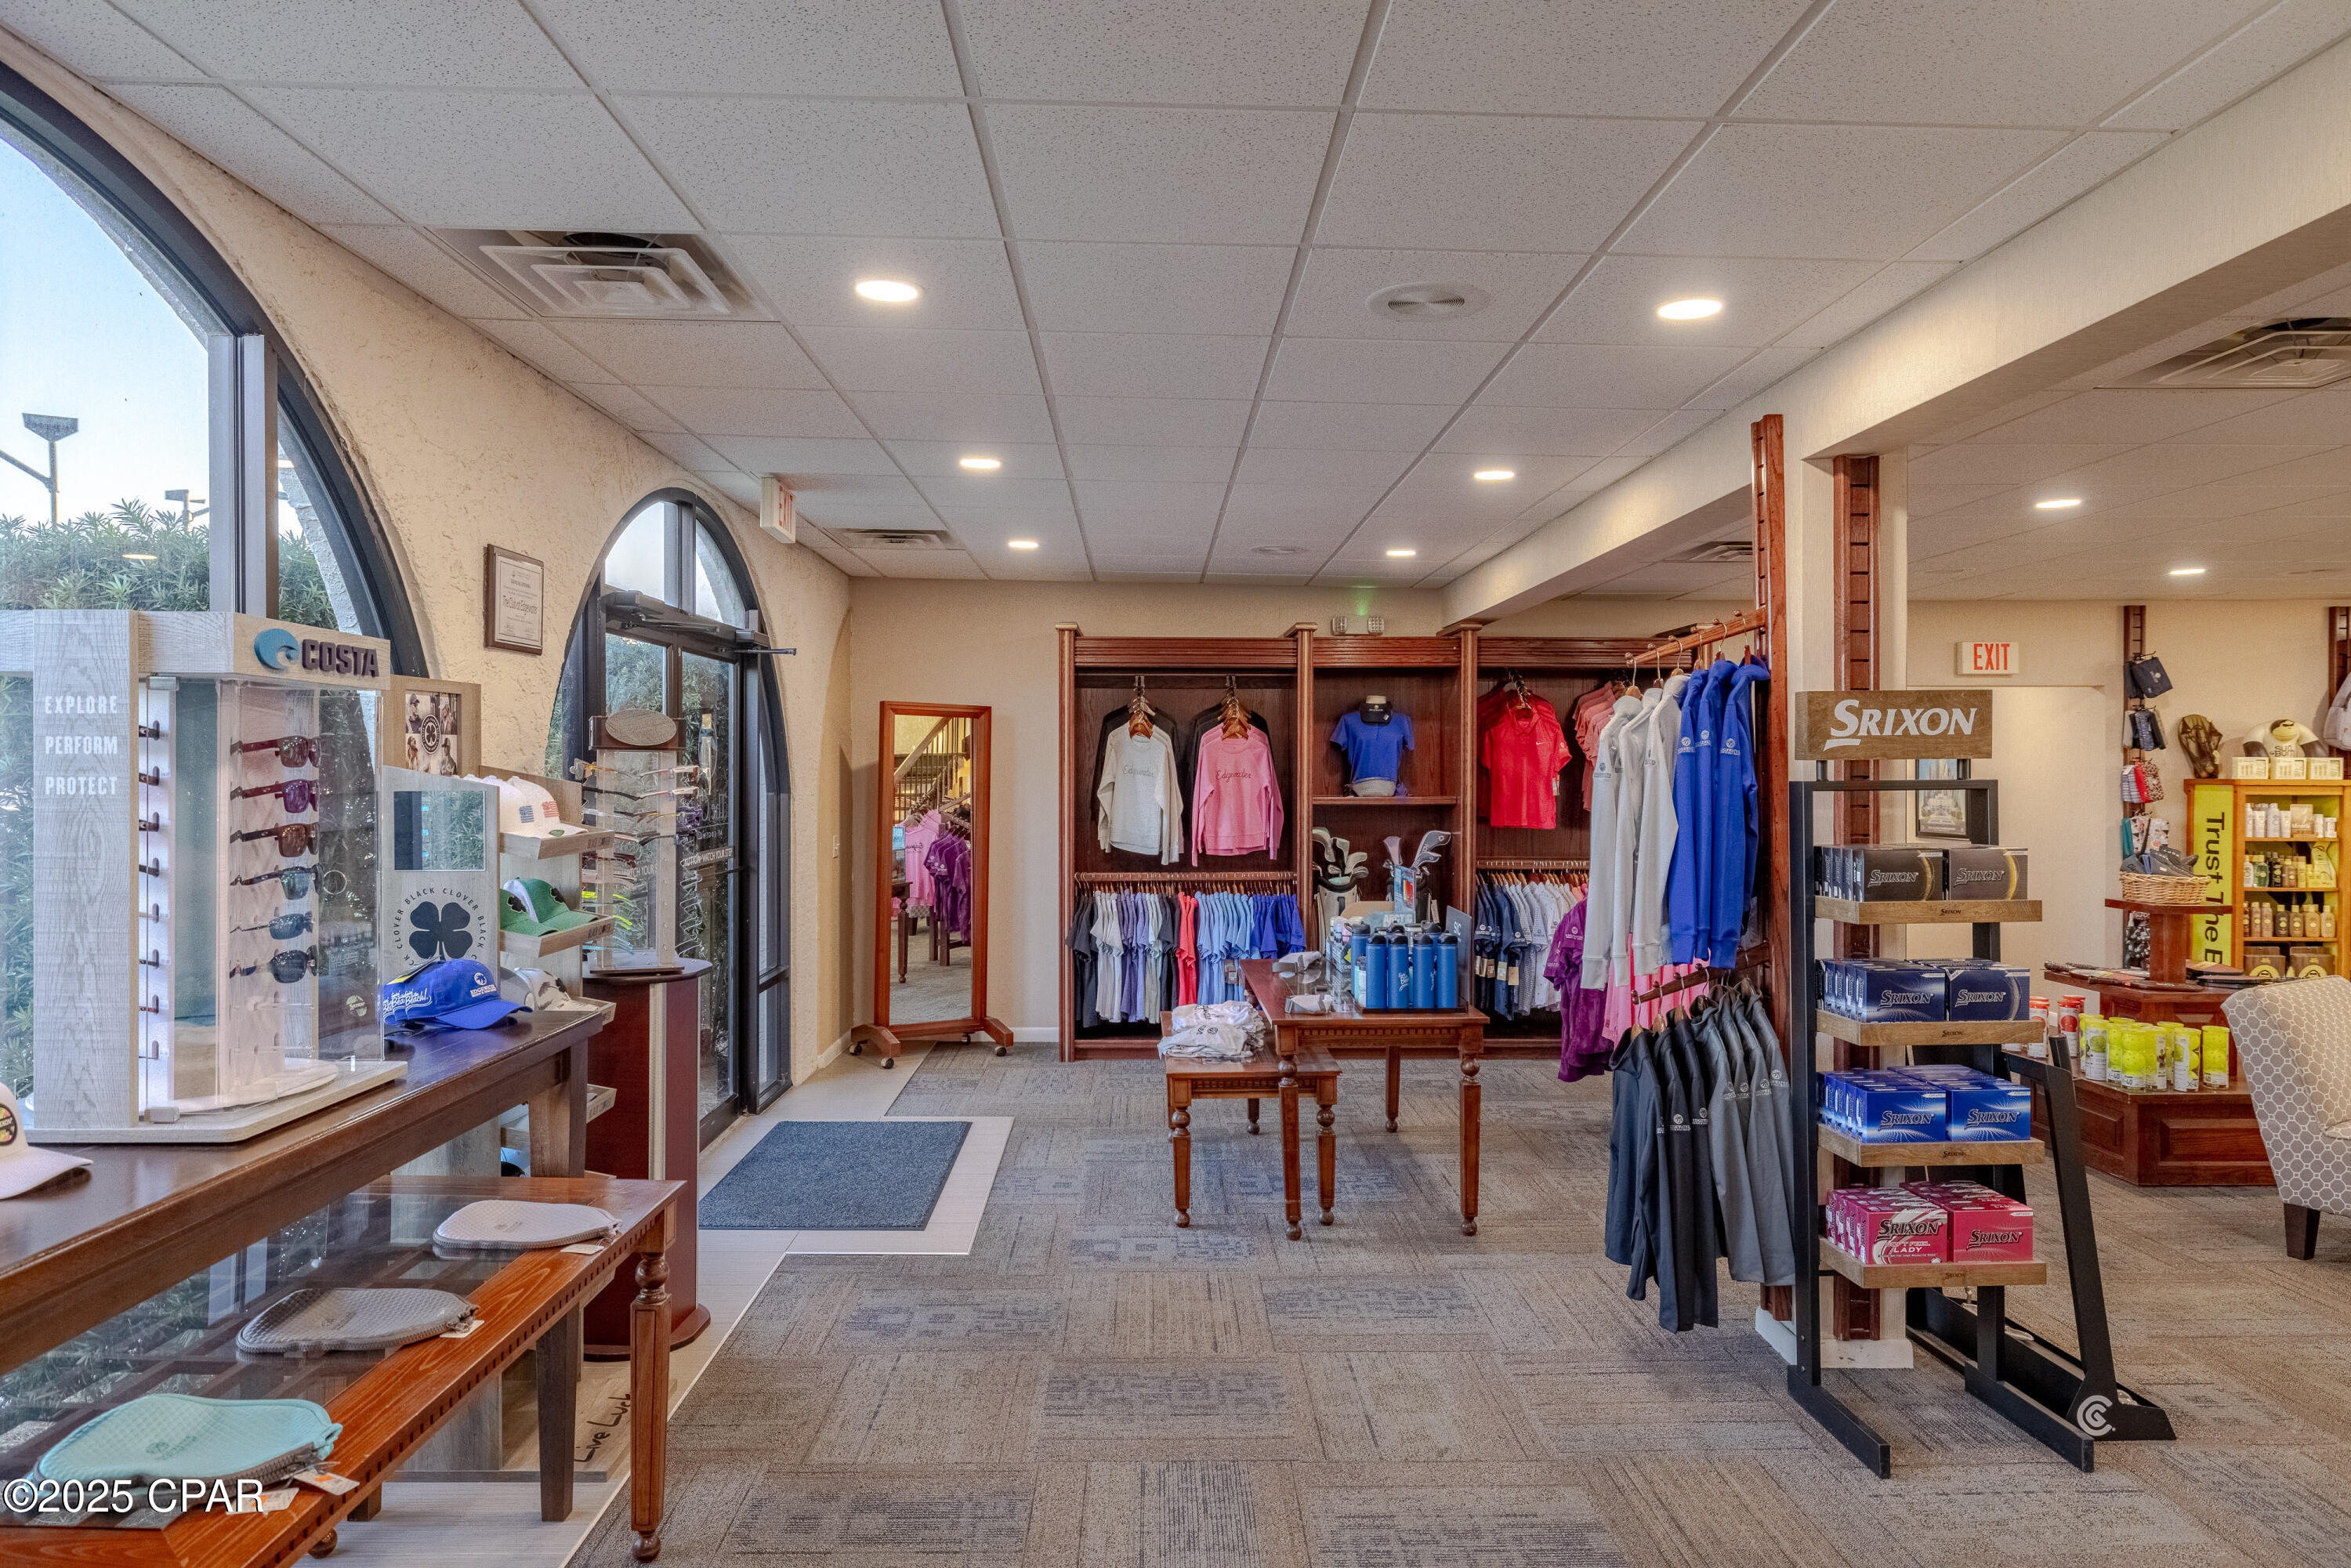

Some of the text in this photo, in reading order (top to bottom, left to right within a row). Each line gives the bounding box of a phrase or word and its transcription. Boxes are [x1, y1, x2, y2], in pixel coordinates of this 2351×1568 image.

[778, 484, 794, 534] EXIT
[302, 639, 380, 678] COSTA
[1973, 643, 2010, 671] EXIT
[45, 695, 118, 715] EXPLORE
[1824, 699, 1978, 751] SRIXON
[45, 735, 118, 755] PERFORM
[1123, 764, 1154, 778] Edgewater
[1216, 770, 1252, 783] Edgewater
[45, 776, 118, 795] PROTECT
[2205, 812, 2225, 884] Trust
[1868, 869, 1919, 888] SRIXON
[1954, 867, 2005, 887] SRIXON
[393, 887, 487, 949] CLOVER BLACK CLOVER BLACK
[1878, 990, 1934, 1012] SRIXON
[1955, 989, 2006, 1008] SRIXON
[1878, 1110, 1935, 1131] SRIXON
[1965, 1108, 2020, 1128] SRIXON
[1875, 1219, 1943, 1241] SRIXON
[1966, 1228, 2023, 1249] SRIXON
[574, 1432, 611, 1463] Live
